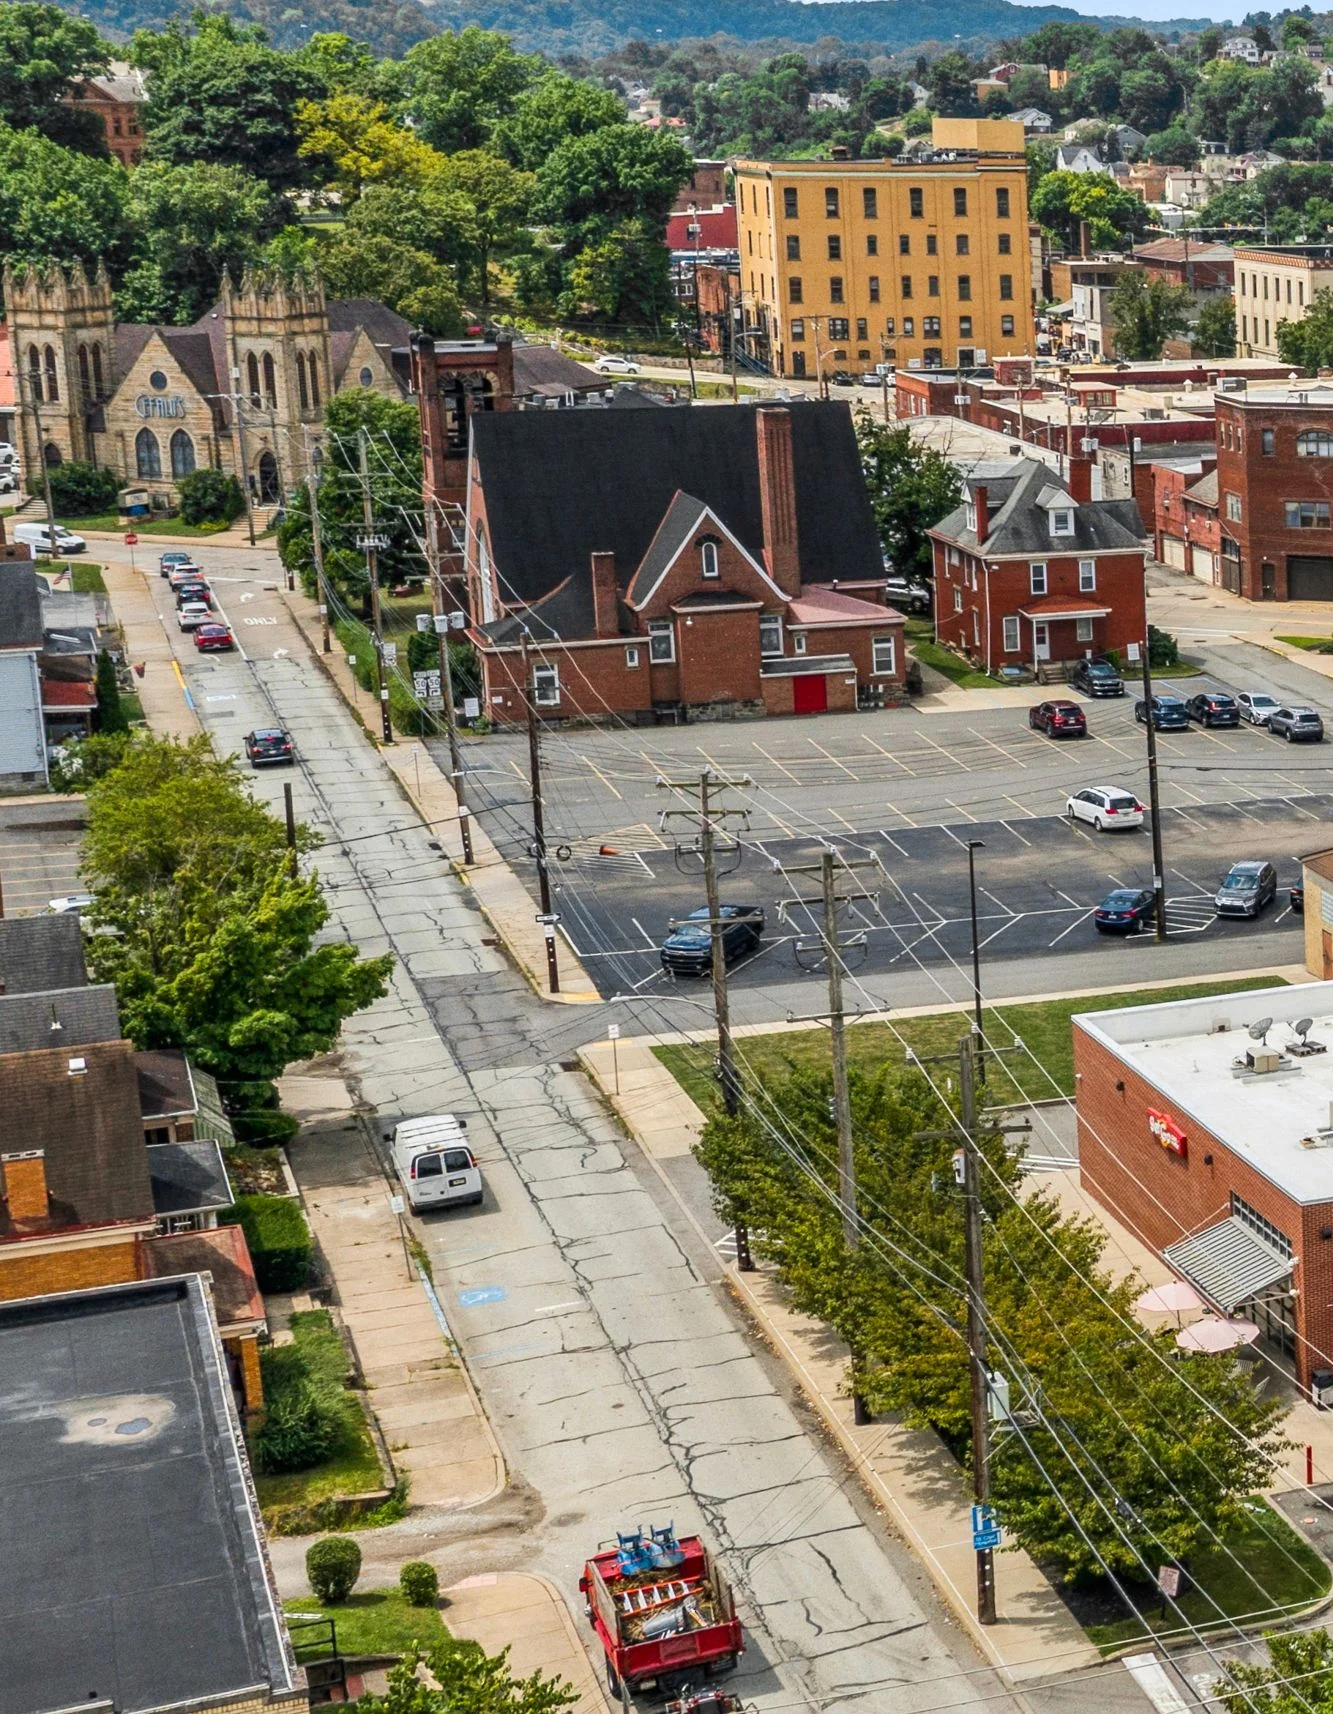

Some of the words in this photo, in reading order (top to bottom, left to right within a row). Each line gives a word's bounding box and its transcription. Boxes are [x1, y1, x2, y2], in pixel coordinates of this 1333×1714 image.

[243, 616, 278, 625] ONLY
[416, 680, 426, 688] 50
[429, 679, 440, 687] 50
